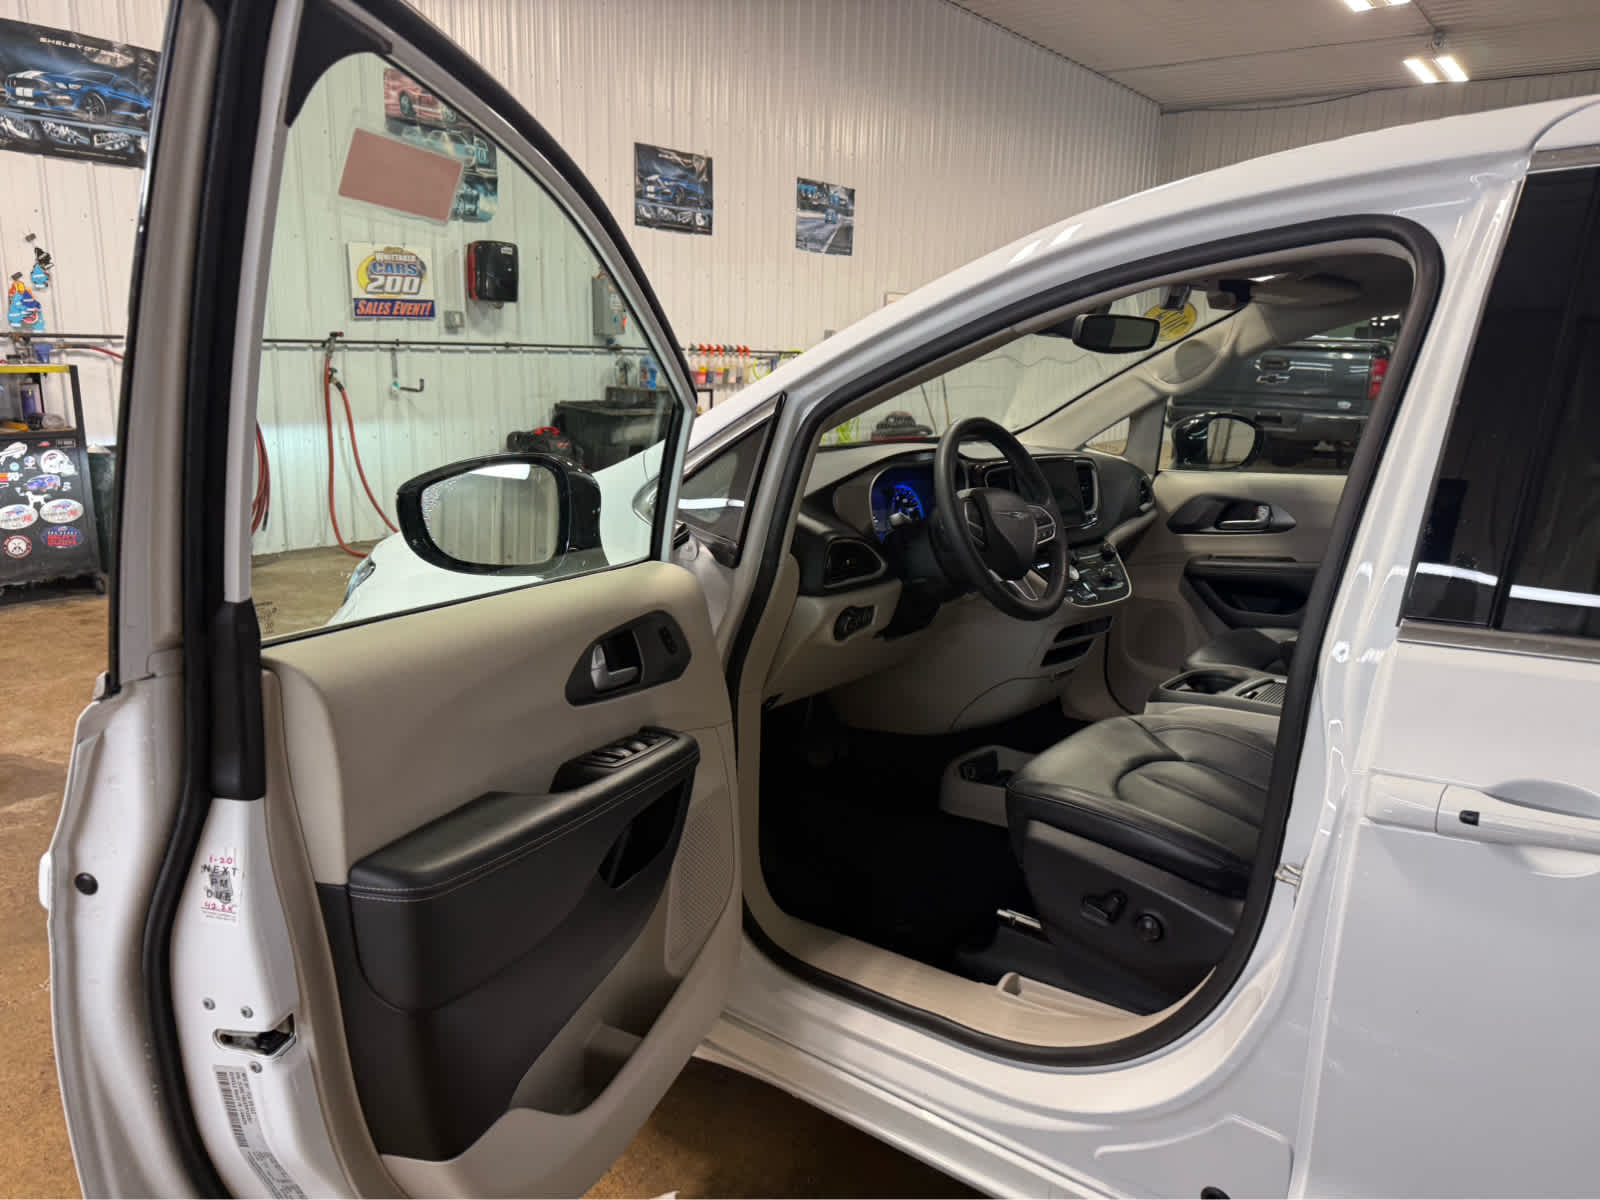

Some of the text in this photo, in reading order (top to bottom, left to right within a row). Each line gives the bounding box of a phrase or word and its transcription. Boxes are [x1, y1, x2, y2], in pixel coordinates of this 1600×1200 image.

[39, 36, 84, 50] SHELBY
[372, 262, 418, 275] CARS
[366, 275, 422, 295] 200
[202, 864, 238, 876] NEXT
[206, 889, 232, 902] DUE
